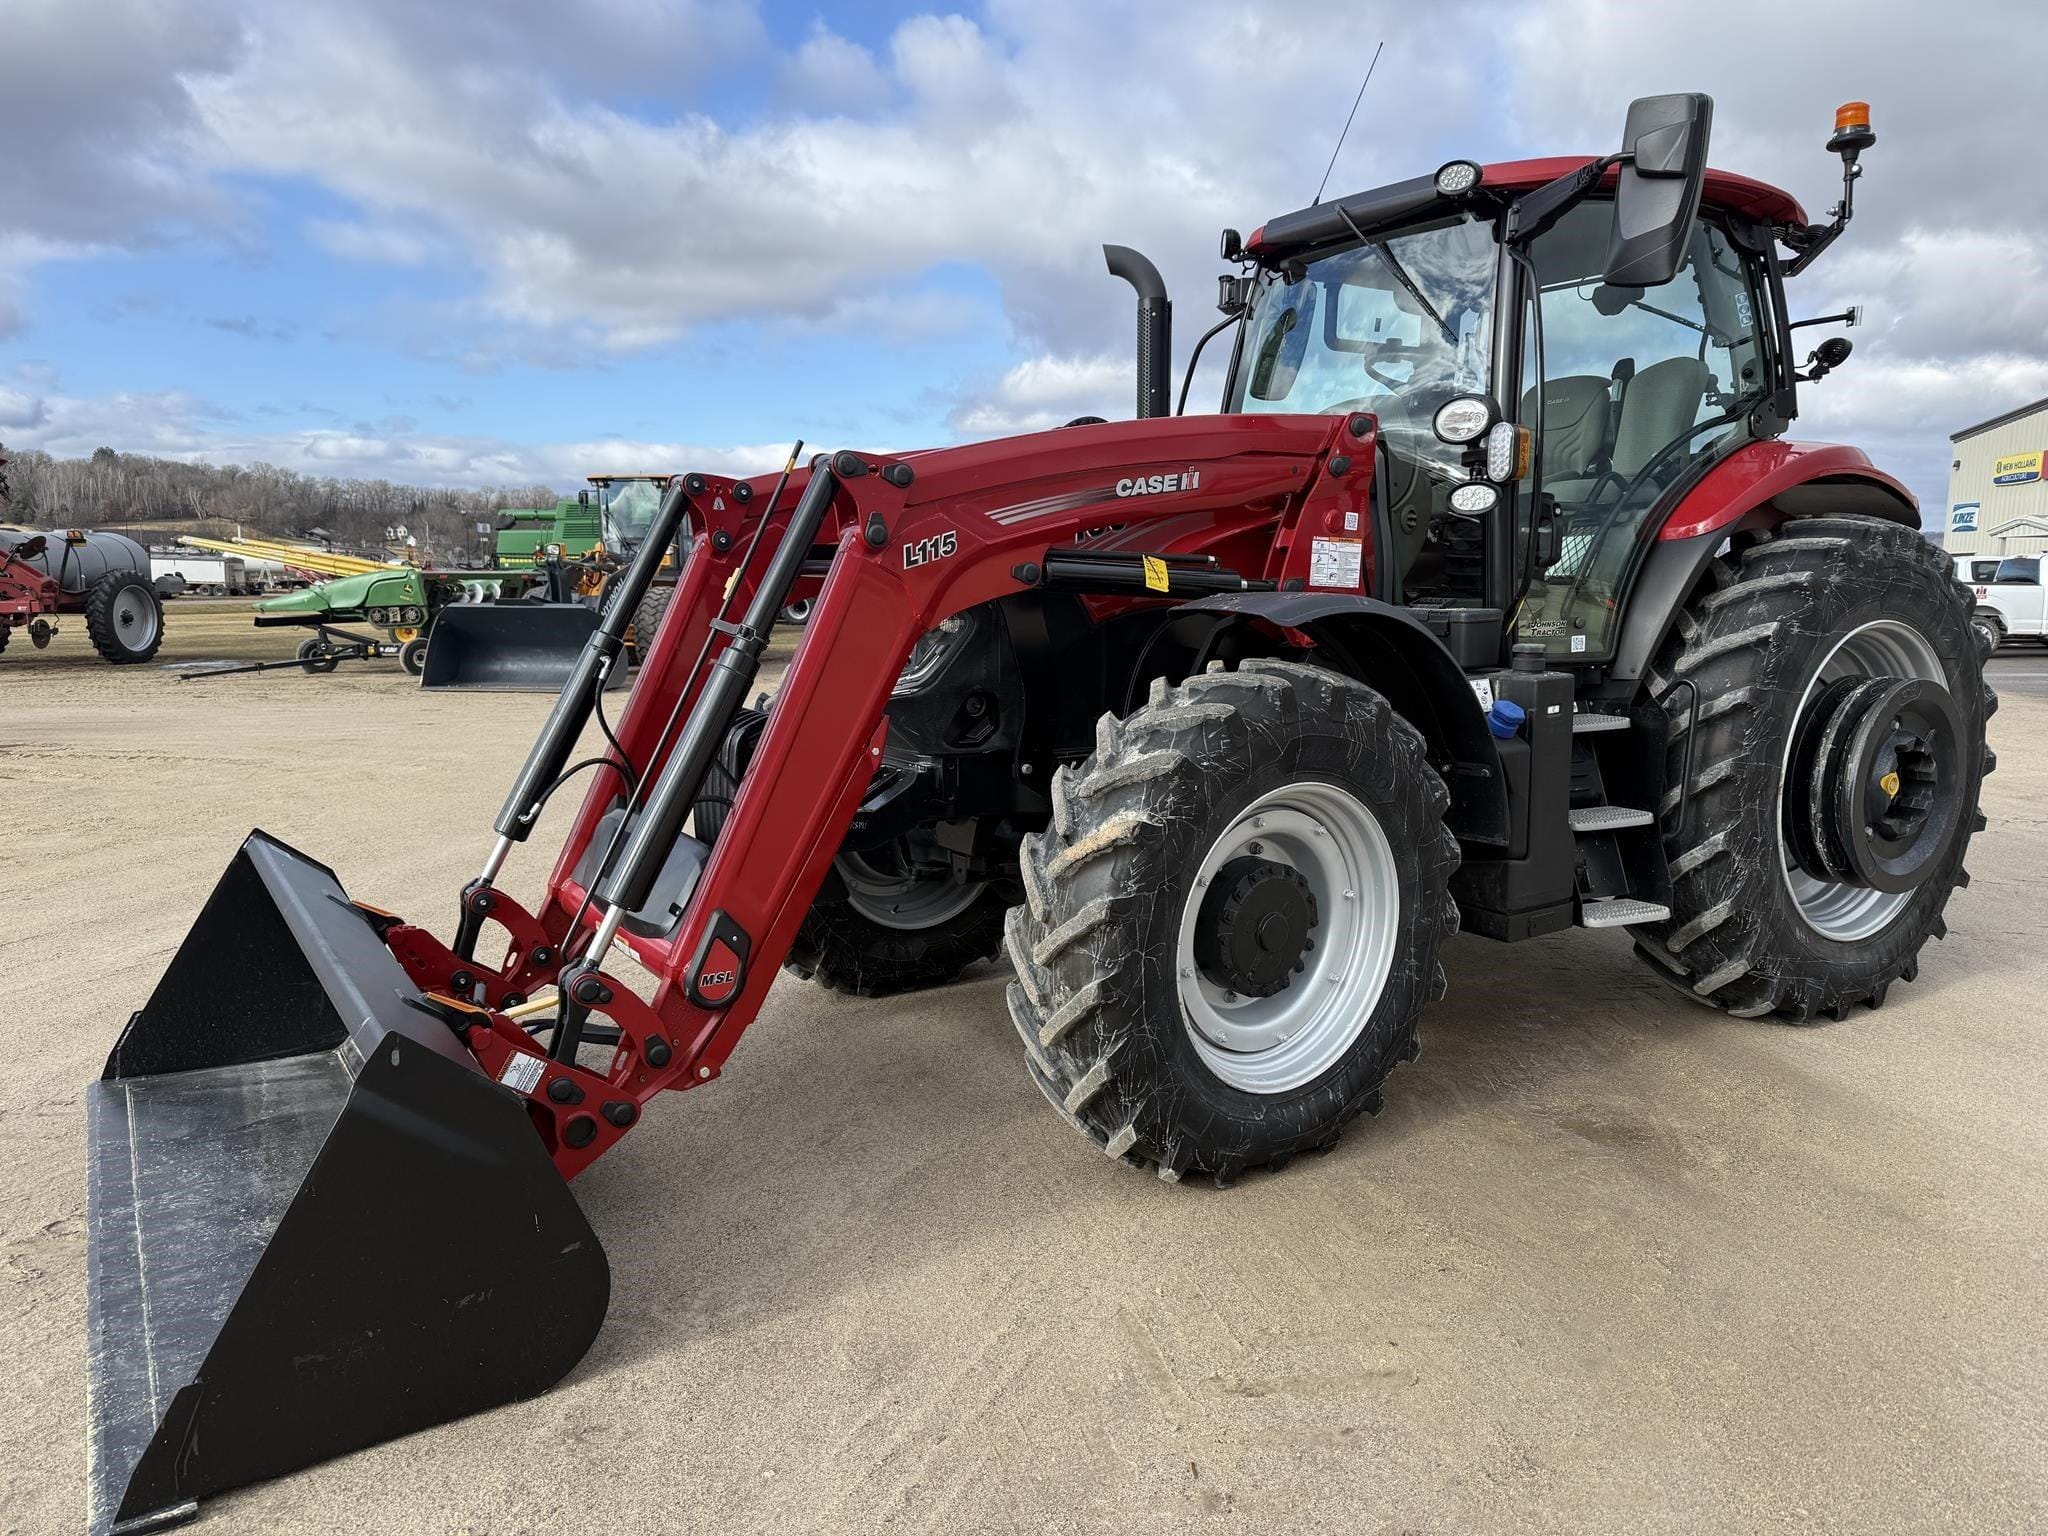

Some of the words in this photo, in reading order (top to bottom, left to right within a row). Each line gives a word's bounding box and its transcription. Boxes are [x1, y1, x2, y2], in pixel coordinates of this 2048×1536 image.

[2003, 462, 2013, 471] NEW
[2014, 458, 2036, 469] HOLLAND
[1115, 473, 1178, 497] CASE
[1952, 511, 1975, 524] KINZE
[903, 530, 957, 570] L115
[1530, 619, 1566, 628] JOHNSON
[1531, 628, 1566, 636] TRACTOR
[700, 971, 733, 987] MSL
